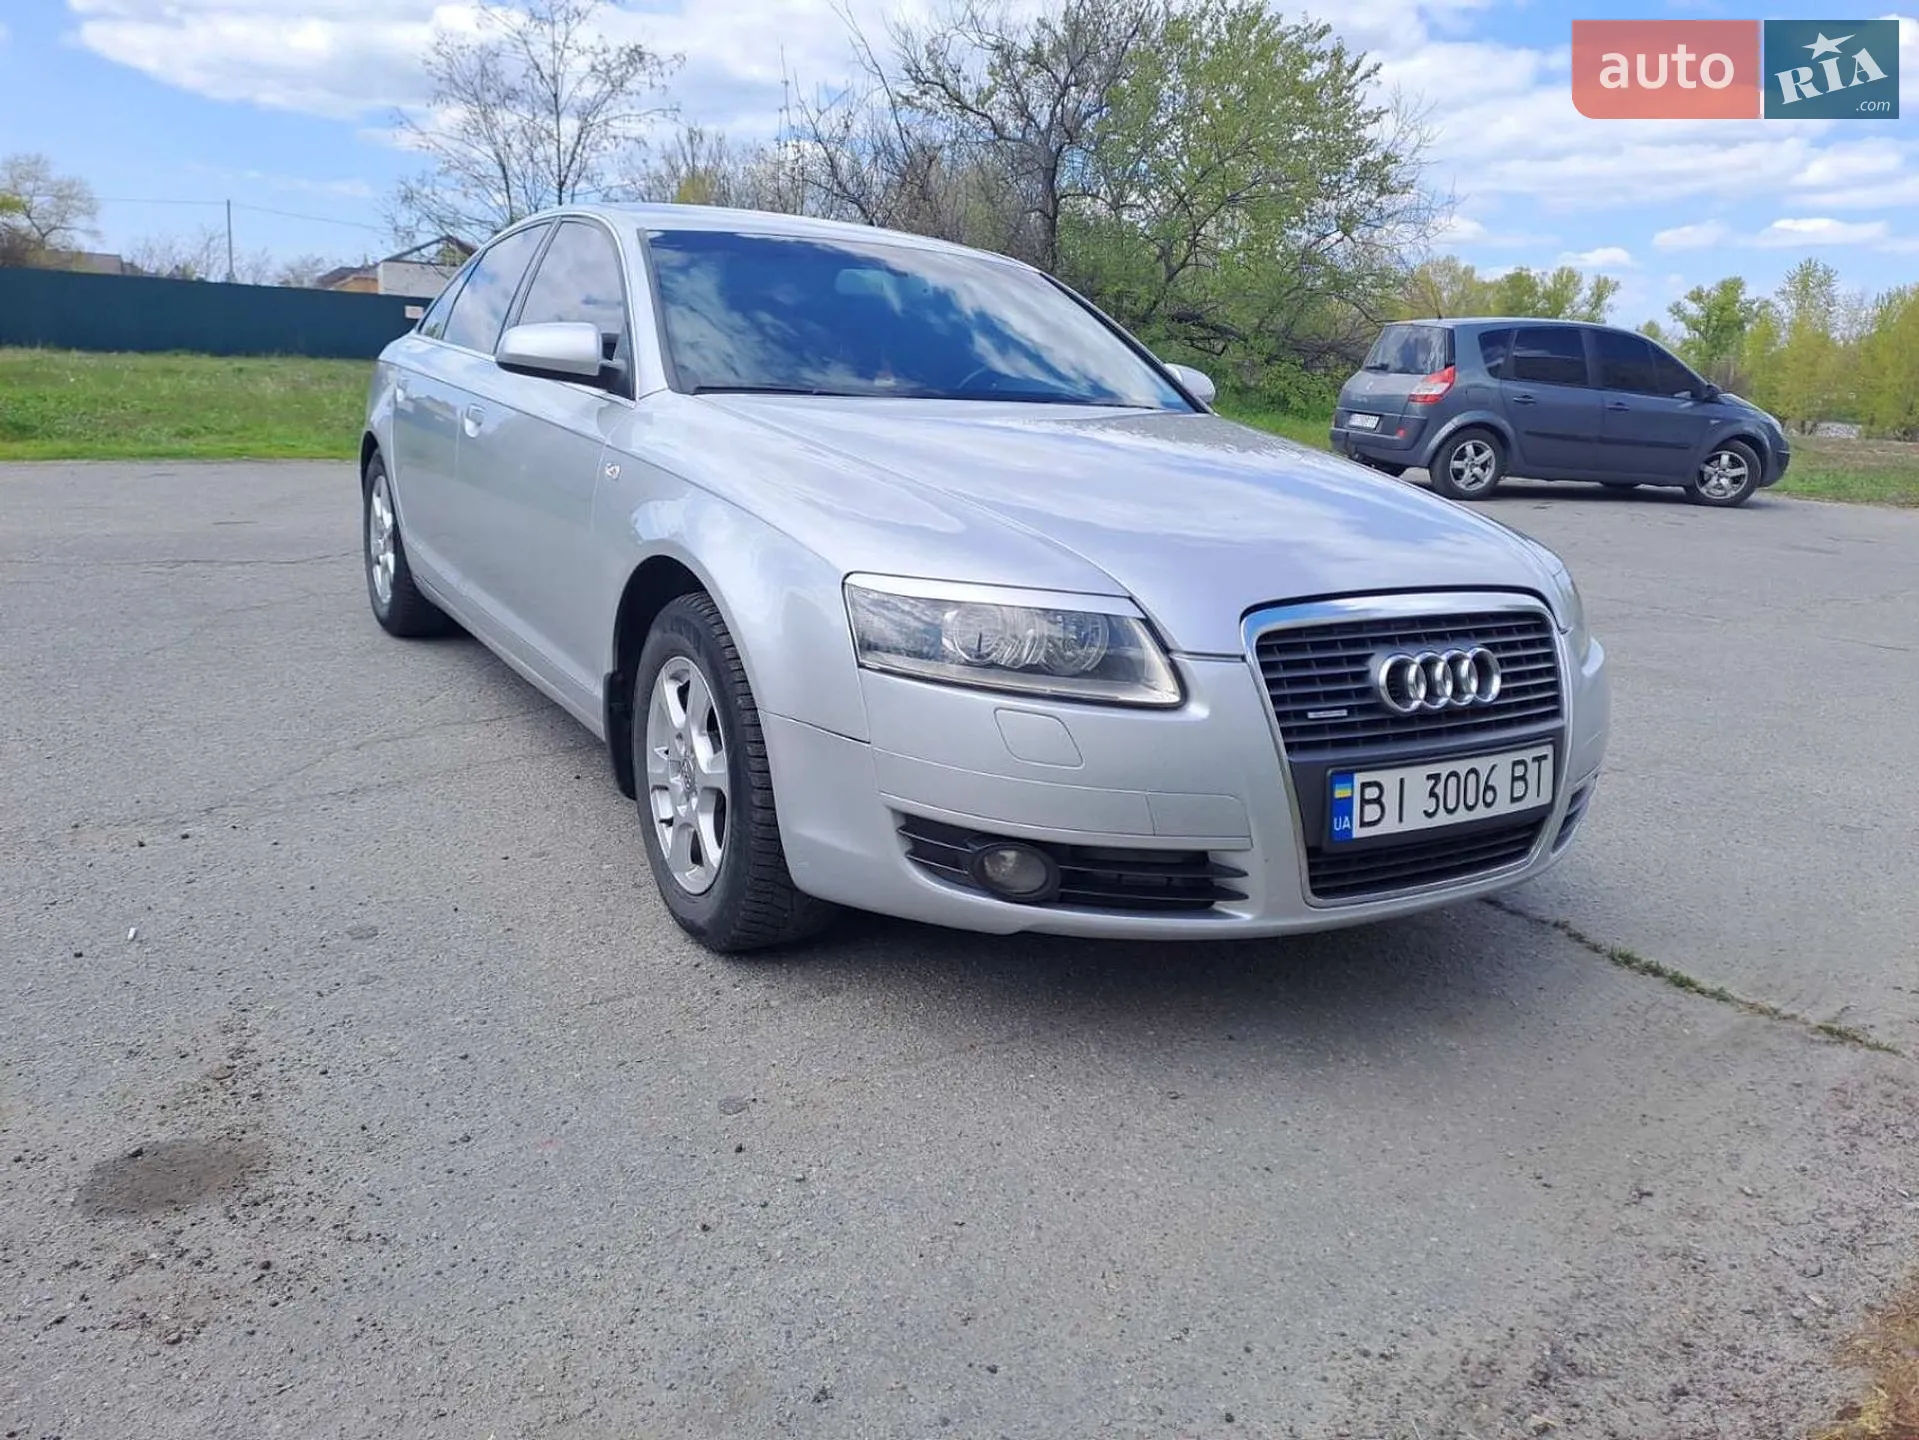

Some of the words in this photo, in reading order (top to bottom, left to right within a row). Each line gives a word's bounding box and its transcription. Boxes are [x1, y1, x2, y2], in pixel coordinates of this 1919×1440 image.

[1359, 777, 1406, 828] BI
[1423, 764, 1498, 819] 3006
[1510, 755, 1549, 803] BT
[1334, 817, 1351, 831] UA
